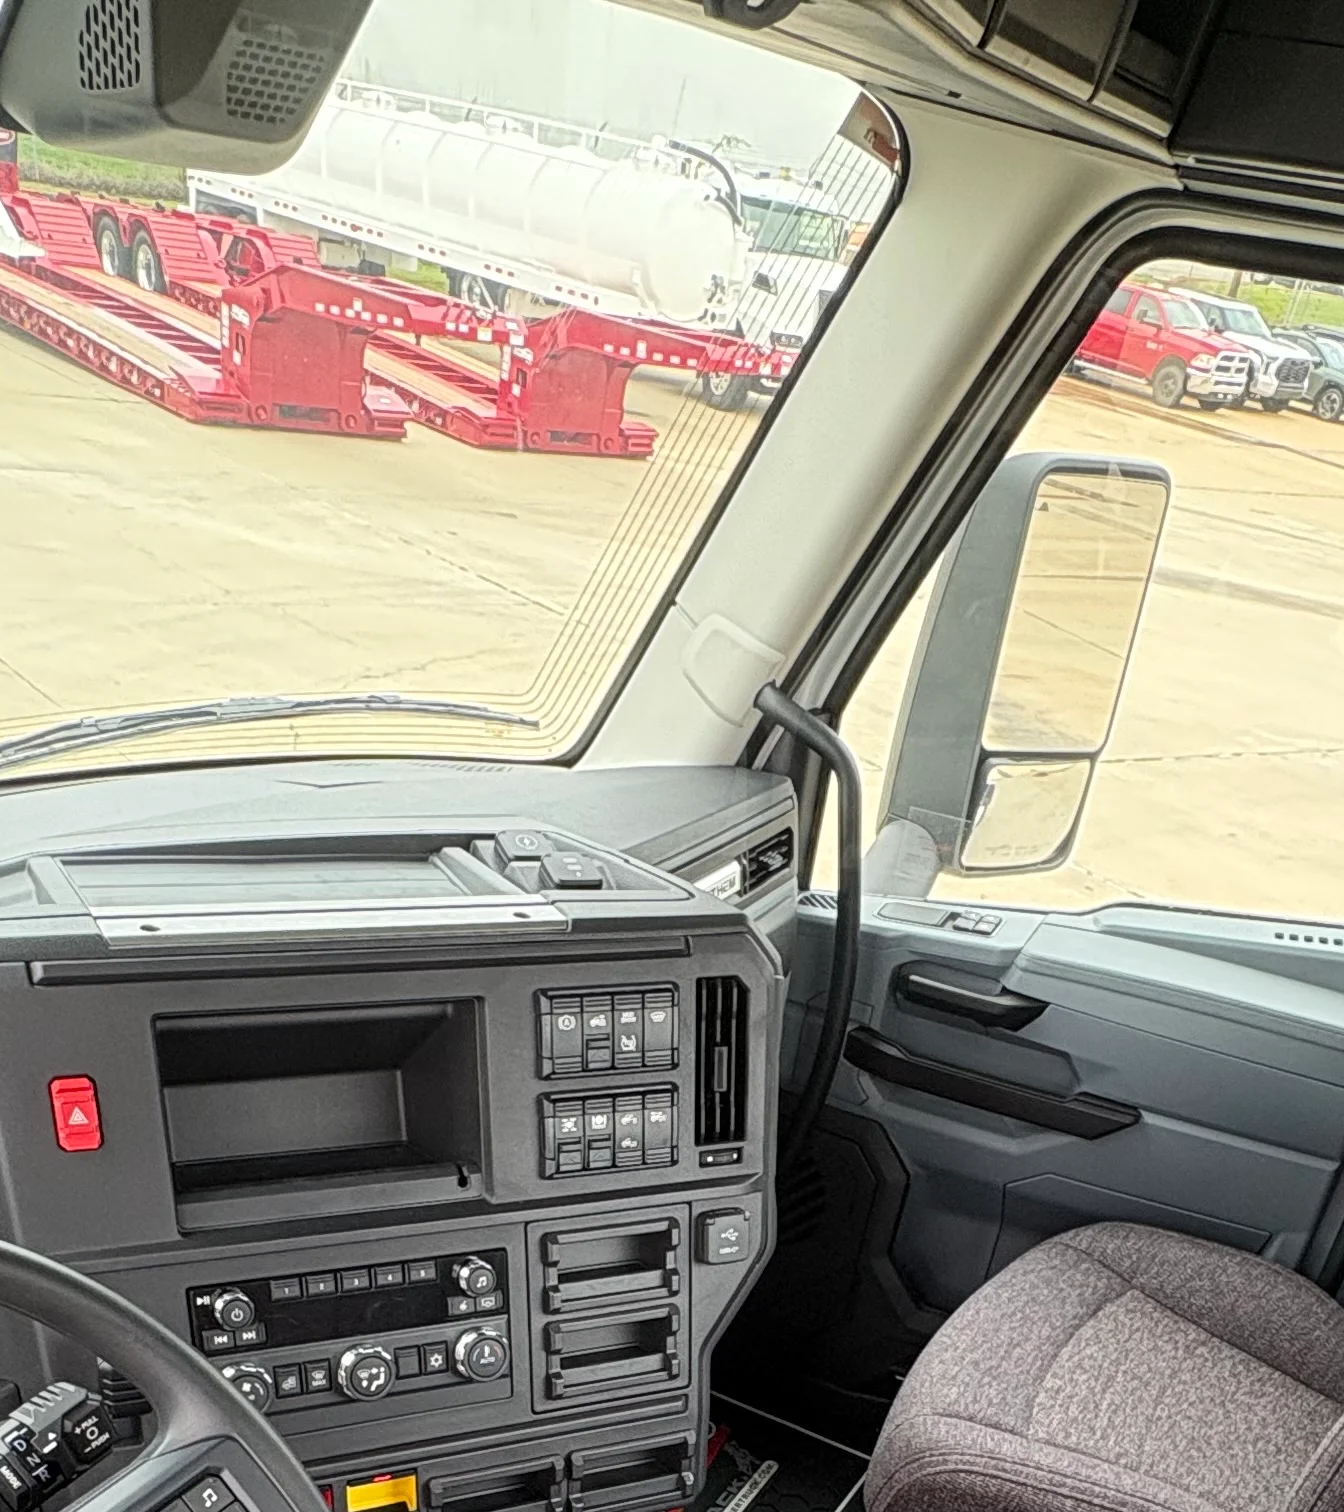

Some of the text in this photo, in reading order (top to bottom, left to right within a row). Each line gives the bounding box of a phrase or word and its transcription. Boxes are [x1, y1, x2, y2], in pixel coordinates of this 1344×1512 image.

[13, 1439, 27, 1452] D
[26, 1452, 41, 1467] N
[0, 1465, 22, 1489] MODE
